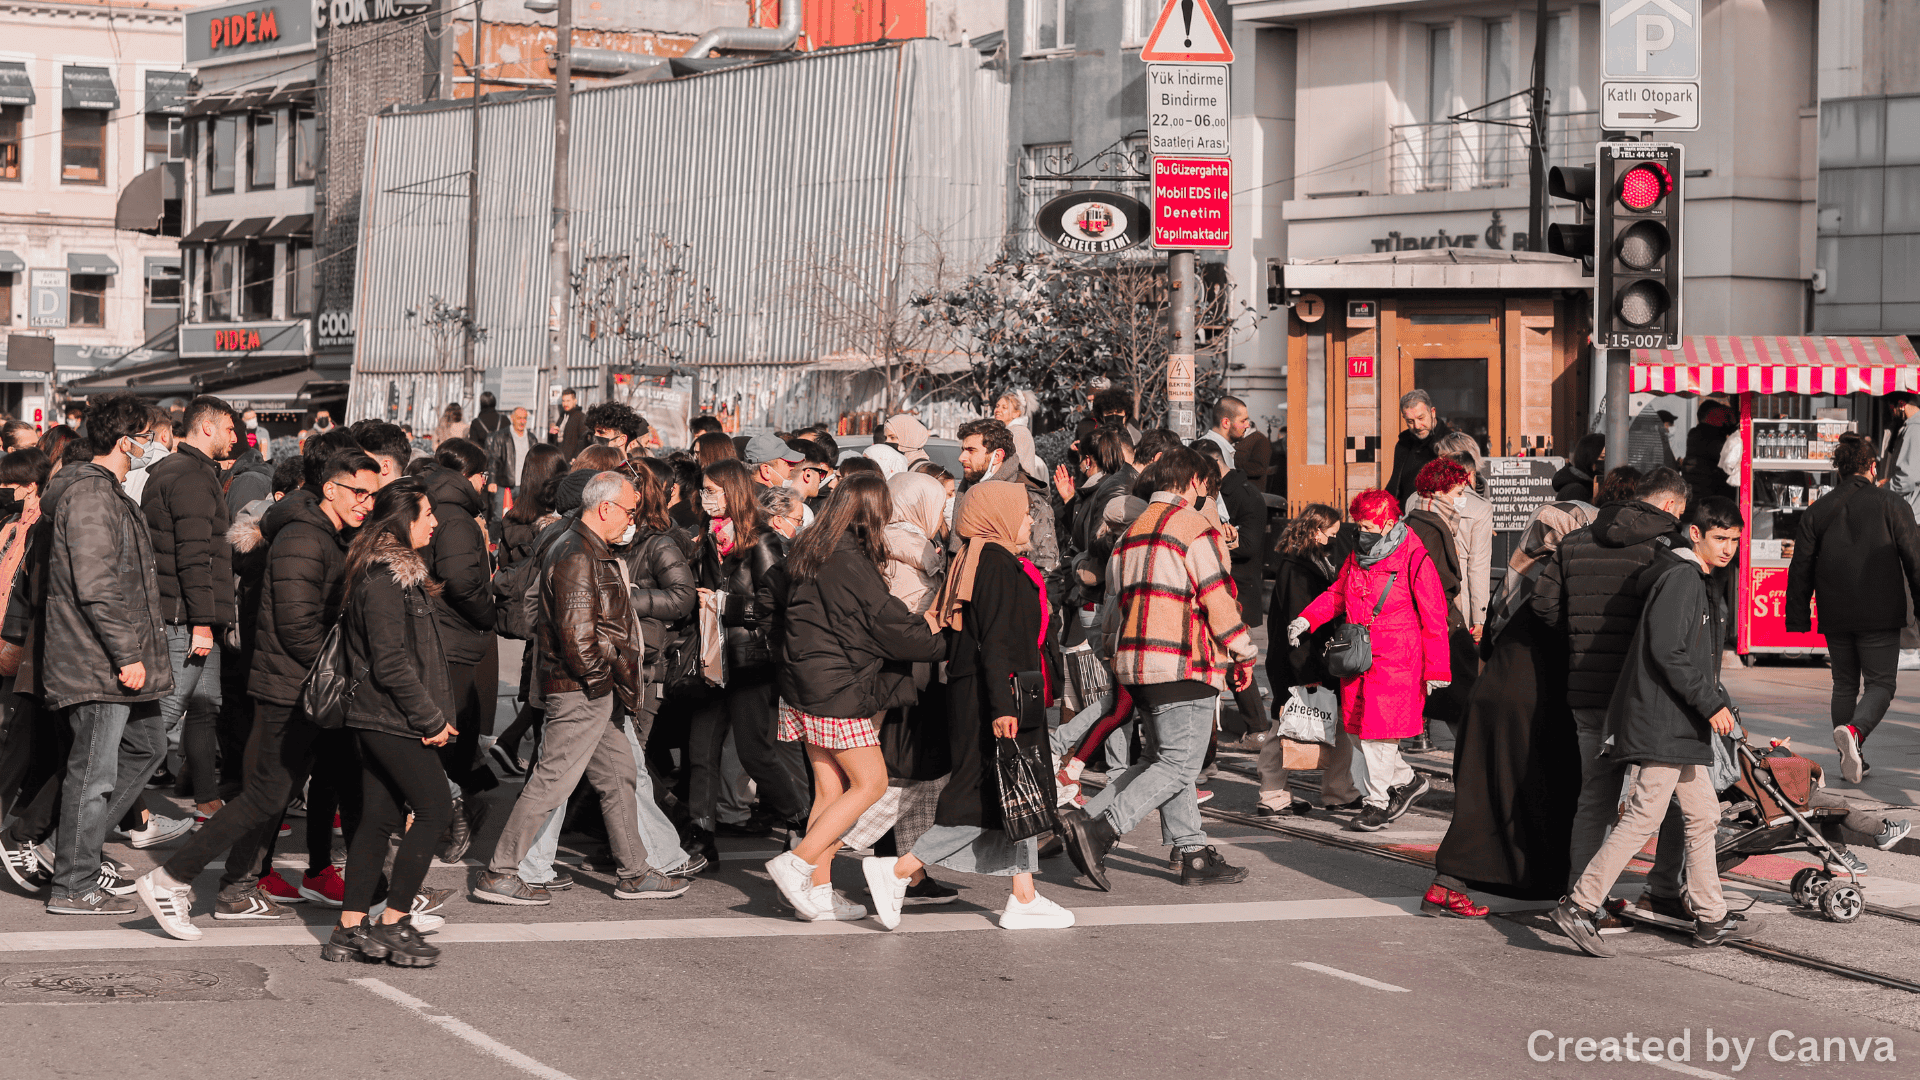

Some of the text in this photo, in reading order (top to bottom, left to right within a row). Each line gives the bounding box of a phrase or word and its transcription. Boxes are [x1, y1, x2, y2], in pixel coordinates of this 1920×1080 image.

[1636, 14, 1675, 72] P
[1151, 71, 1174, 85] Yük
[1161, 92, 1217, 107] Bindirme
[1607, 88, 1693, 105] Katlı Otopark
[1153, 135, 1226, 149] Saatleri Arası
[1156, 162, 1229, 178] Bu Güzergahta
[1156, 186, 1228, 200] Mobil EDS ile
[1163, 206, 1221, 219] Denetim
[1156, 226, 1229, 242] Yapılmaktadır
[1057, 232, 1132, 252] İSKELE CAMİ
[37, 289, 59, 315] D
[1612, 334, 1663, 348] 15-007
[1352, 360, 1368, 374] 1/1
[1492, 487, 1530, 495] NOKTASI
